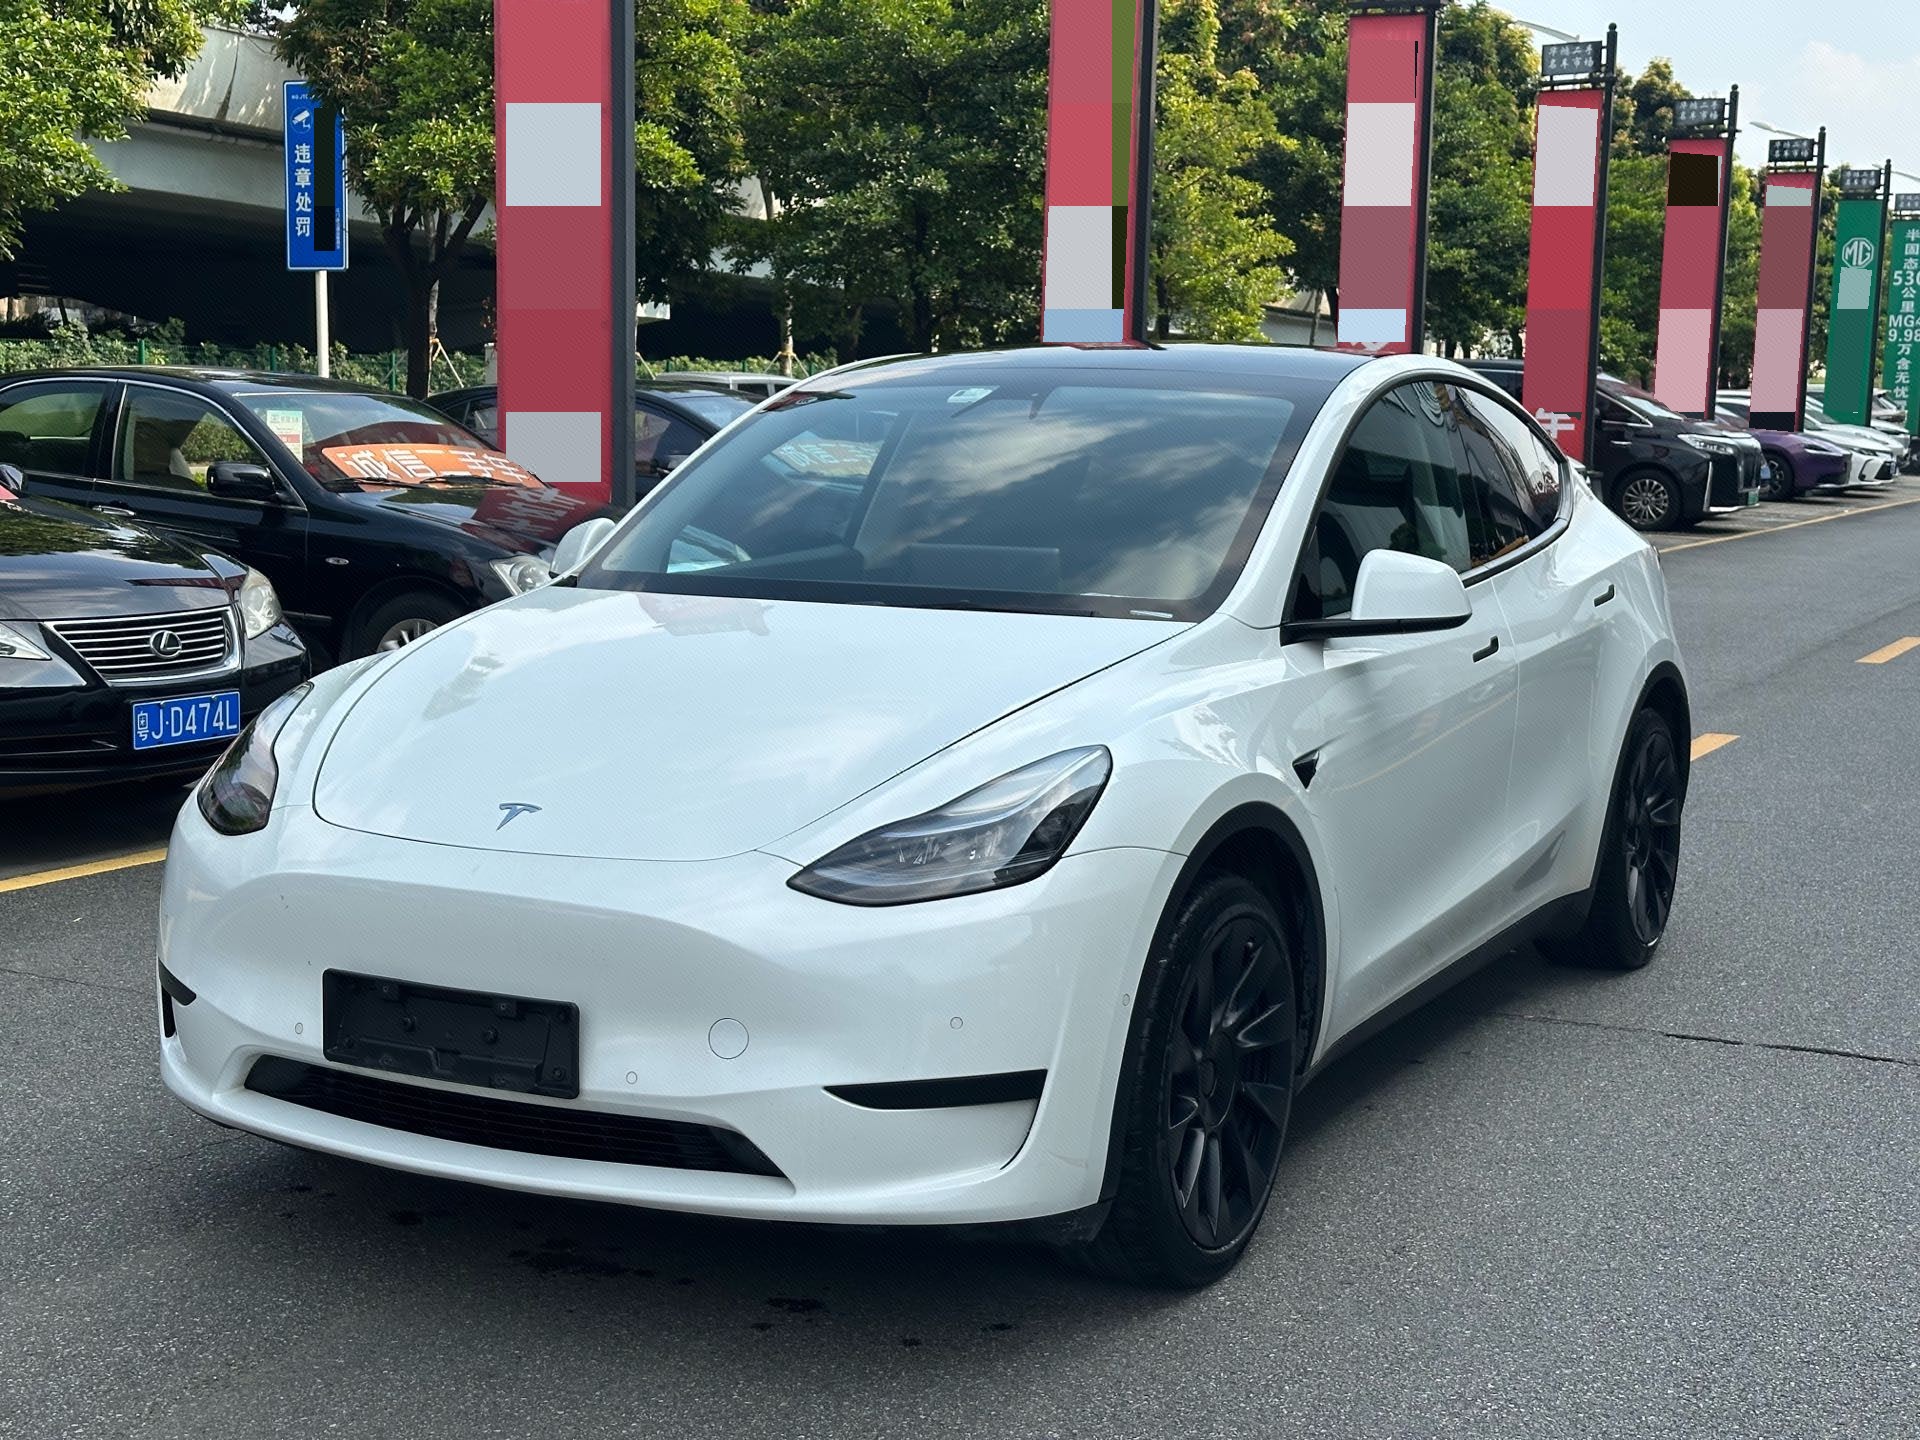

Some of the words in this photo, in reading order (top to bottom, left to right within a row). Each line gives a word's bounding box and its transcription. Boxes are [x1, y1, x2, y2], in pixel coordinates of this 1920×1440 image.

[294, 143, 312, 237] 违章处罚
[1844, 240, 1872, 266] MG
[1900, 286, 1917, 313] 公里
